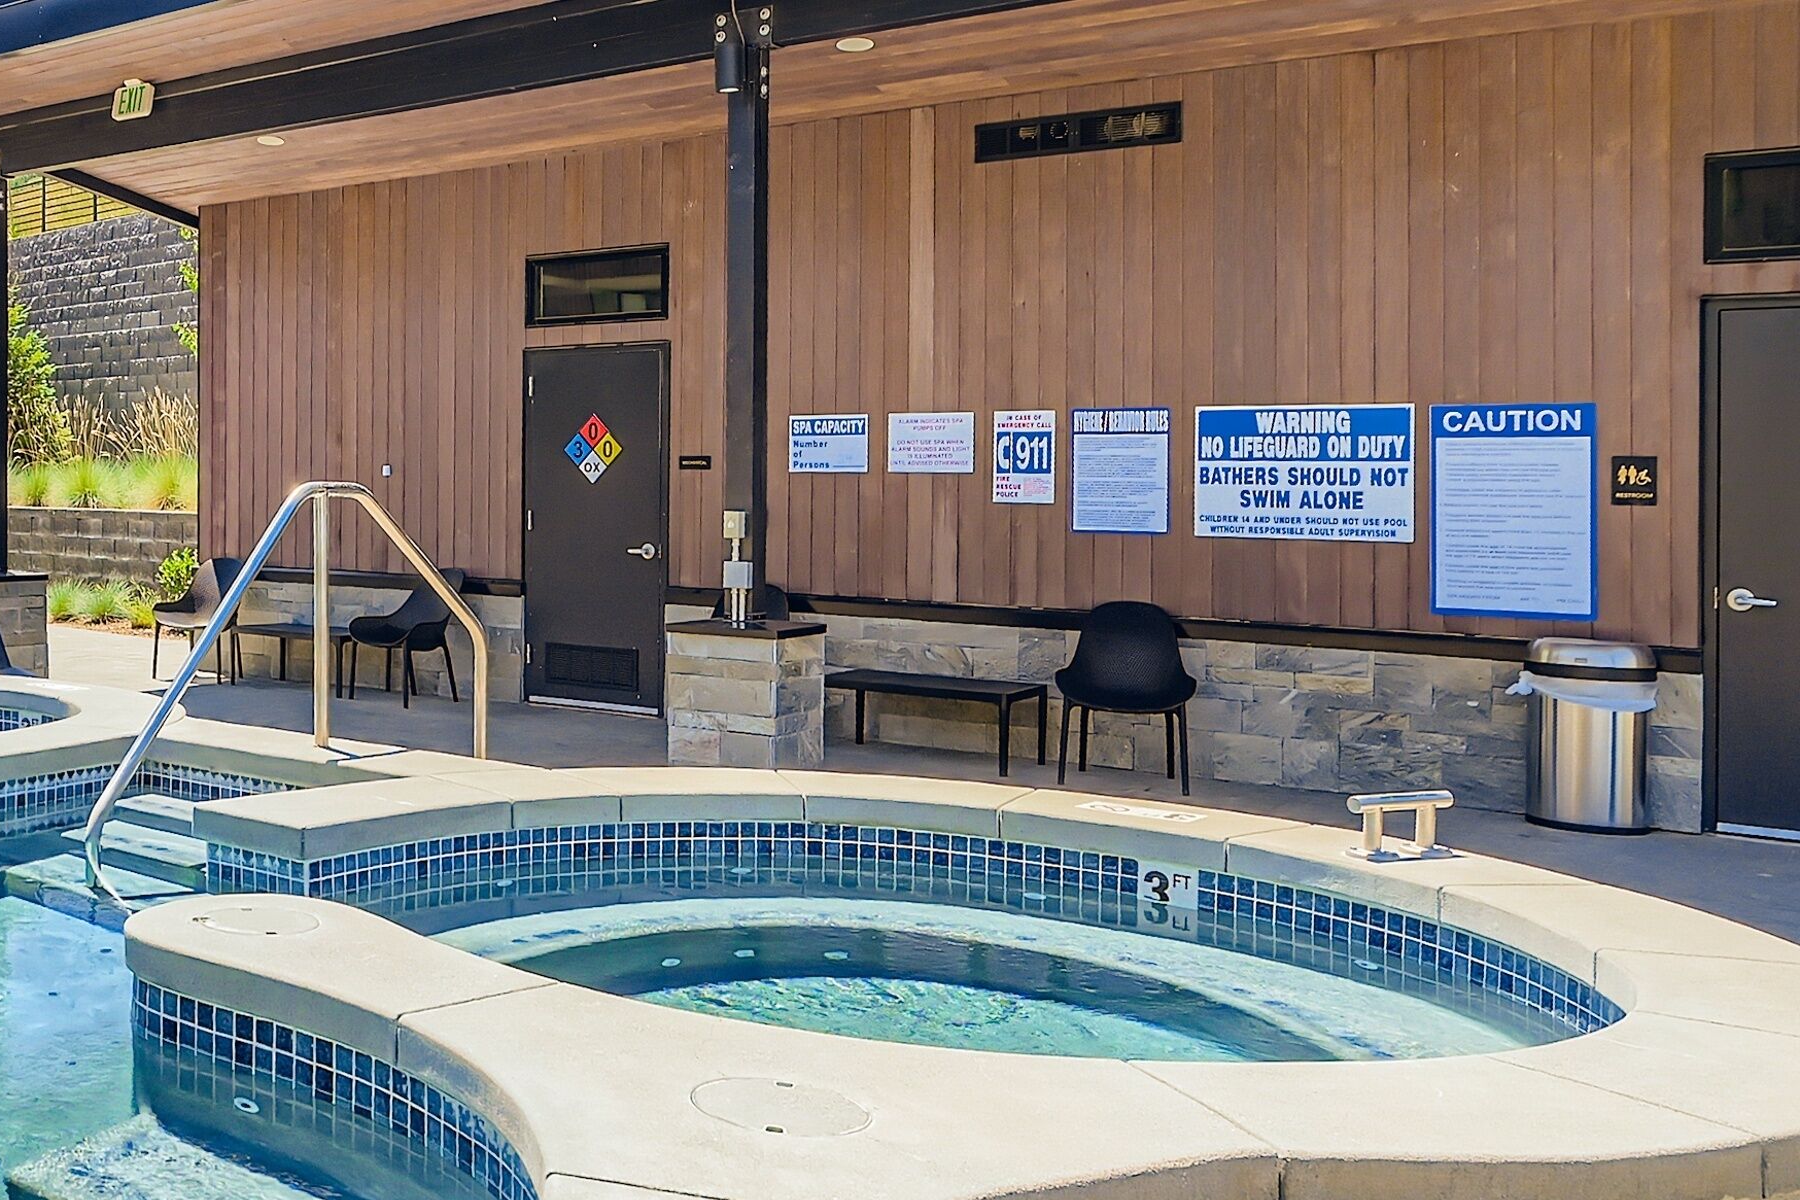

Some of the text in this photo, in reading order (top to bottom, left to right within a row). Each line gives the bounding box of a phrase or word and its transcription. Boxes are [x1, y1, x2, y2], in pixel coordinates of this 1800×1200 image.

[118, 85, 146, 115] EXIT
[792, 419, 865, 434] SPA CAPACITY
[1255, 410, 1351, 434] WARNING
[1442, 409, 1582, 433] CAUTION
[588, 422, 598, 440] 0
[573, 440, 613, 458] 3 0
[793, 440, 828, 448] Number
[1015, 435, 1048, 470] 911
[1201, 436, 1406, 459] NO LIFEGUARD ON DUTY
[793, 450, 802, 458] of
[584, 462, 600, 473] OX
[793, 460, 830, 469] Persons
[1199, 466, 1409, 487] BATHERS SHOULD NOT
[1239, 489, 1364, 510] SWIM ALONE
[1199, 514, 1239, 523] CHILDREN
[1242, 515, 1250, 523] 14
[1253, 516, 1271, 524] AND
[1273, 516, 1302, 524] UNDER
[1305, 517, 1339, 525] SHOULD
[1363, 518, 1380, 526] USE
[1384, 519, 1408, 527] POOL
[1210, 525, 1397, 537] WITHOUT RESPONSIBLE ADULT SUPERVISION
[1143, 870, 1192, 902] 3 FT
